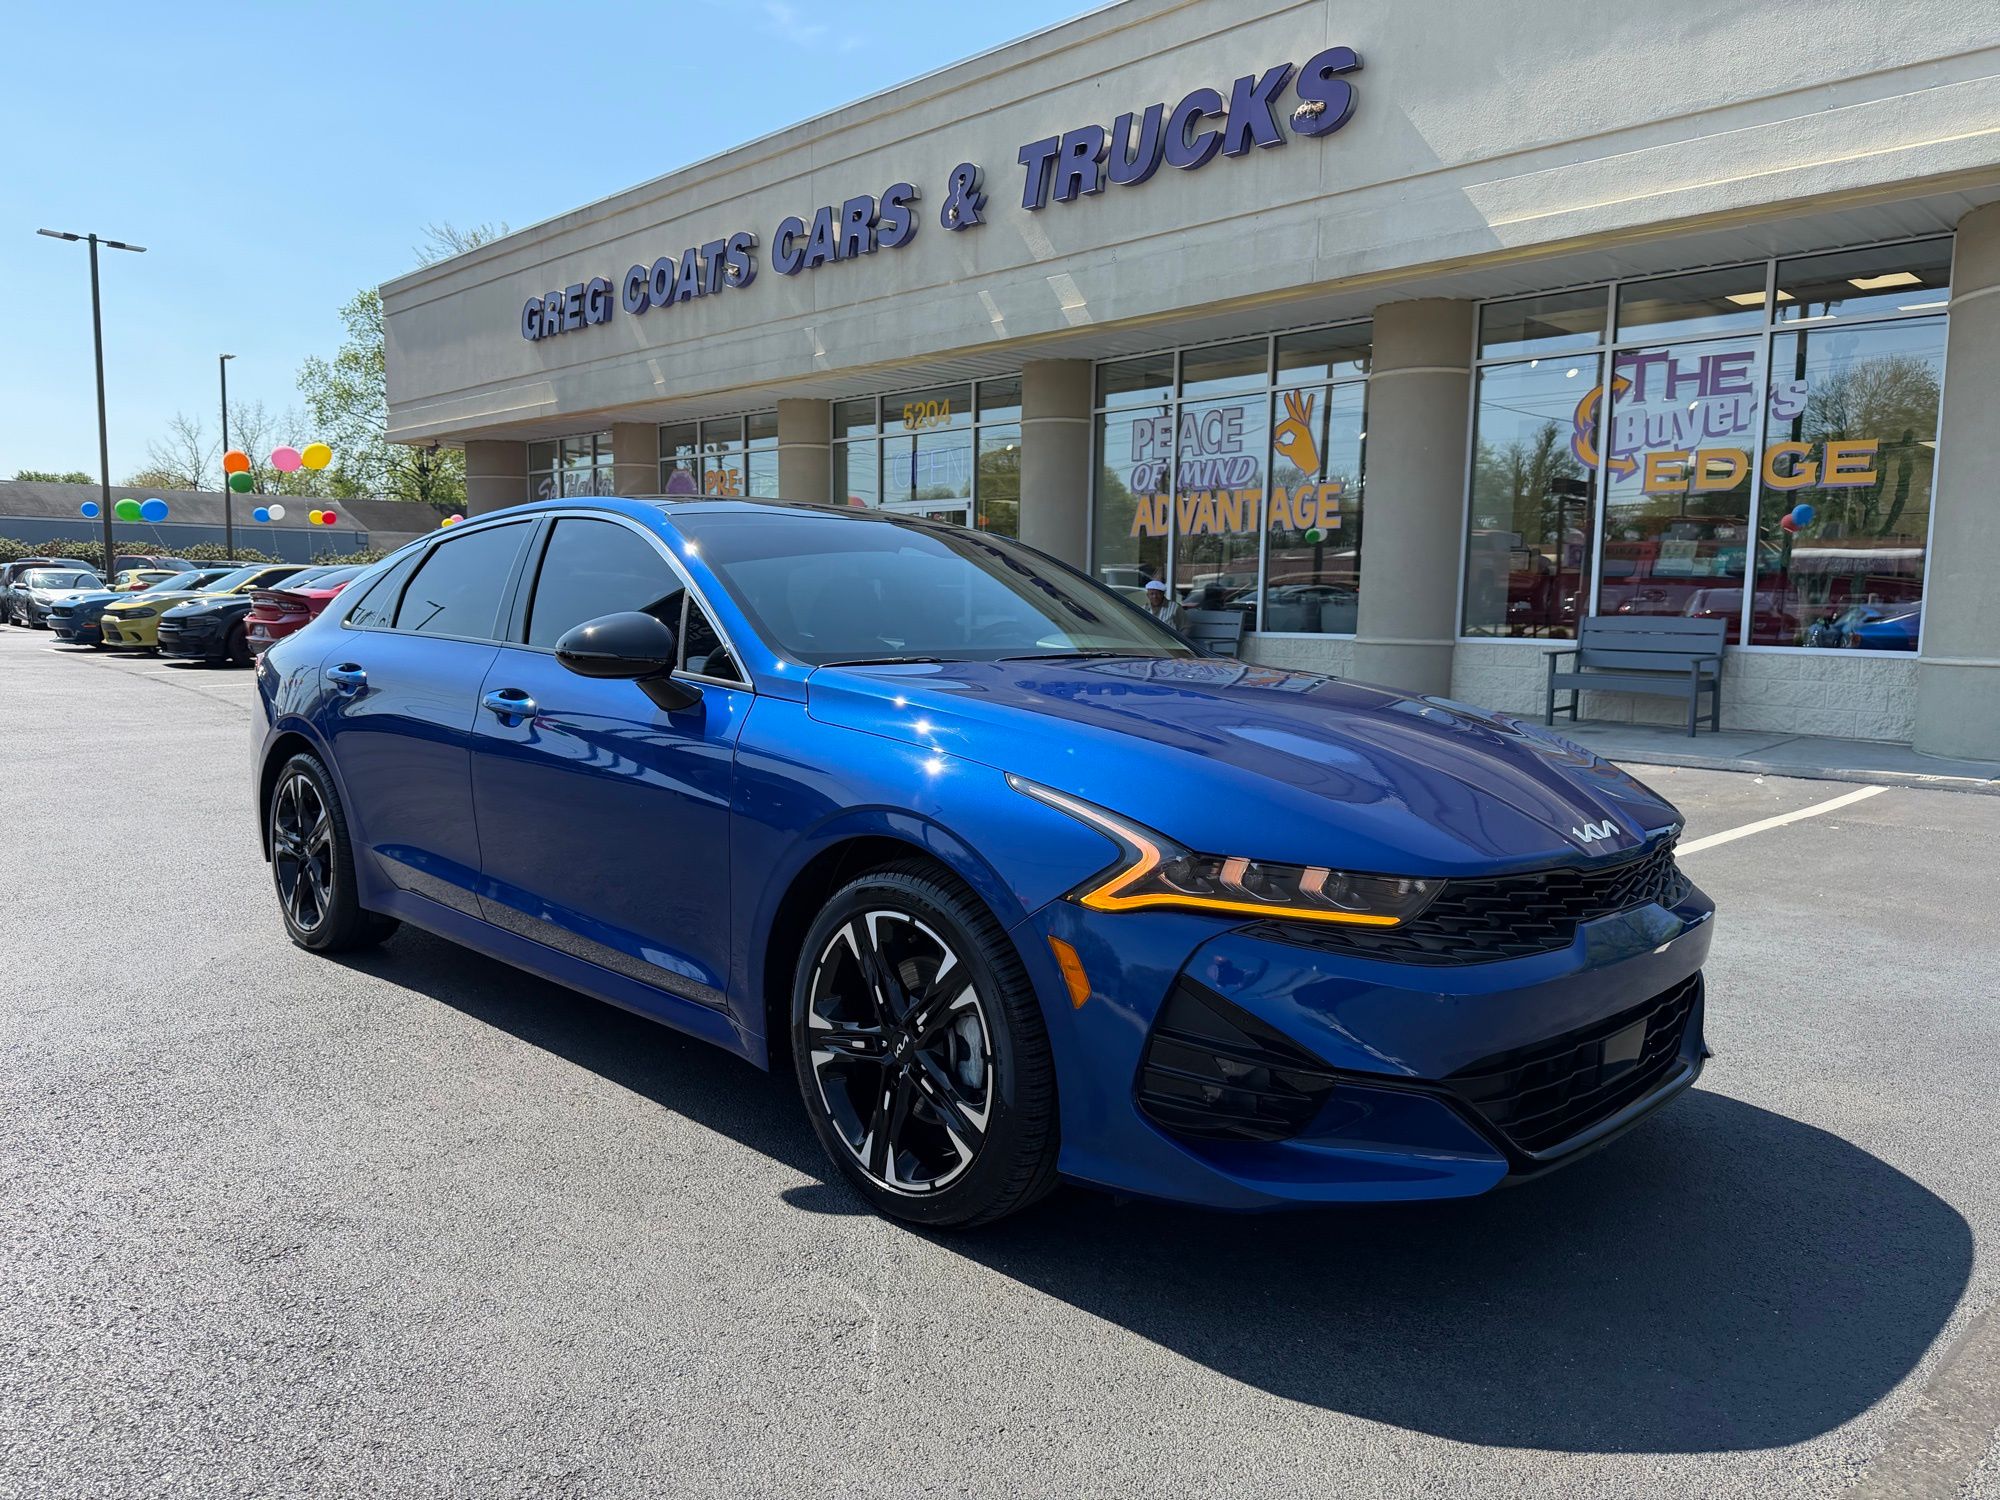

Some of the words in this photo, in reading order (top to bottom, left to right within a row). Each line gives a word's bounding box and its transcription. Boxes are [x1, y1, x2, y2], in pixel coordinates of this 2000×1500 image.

[521, 276, 614, 341] GREG
[621, 231, 759, 316] COATS
[771, 182, 920, 276] CARS
[940, 162, 988, 232] &
[1017, 46, 1364, 211] TRUCKS
[1616, 350, 1755, 406] THE
[903, 398, 952, 432] 5204
[1131, 406, 1244, 462] PEACE
[894, 446, 968, 489] OPEN
[1131, 462, 1170, 494] OF
[1175, 455, 1258, 490] MIND
[1642, 438, 1880, 496] EDGE
[1130, 481, 1344, 538] ADVANTAGE
